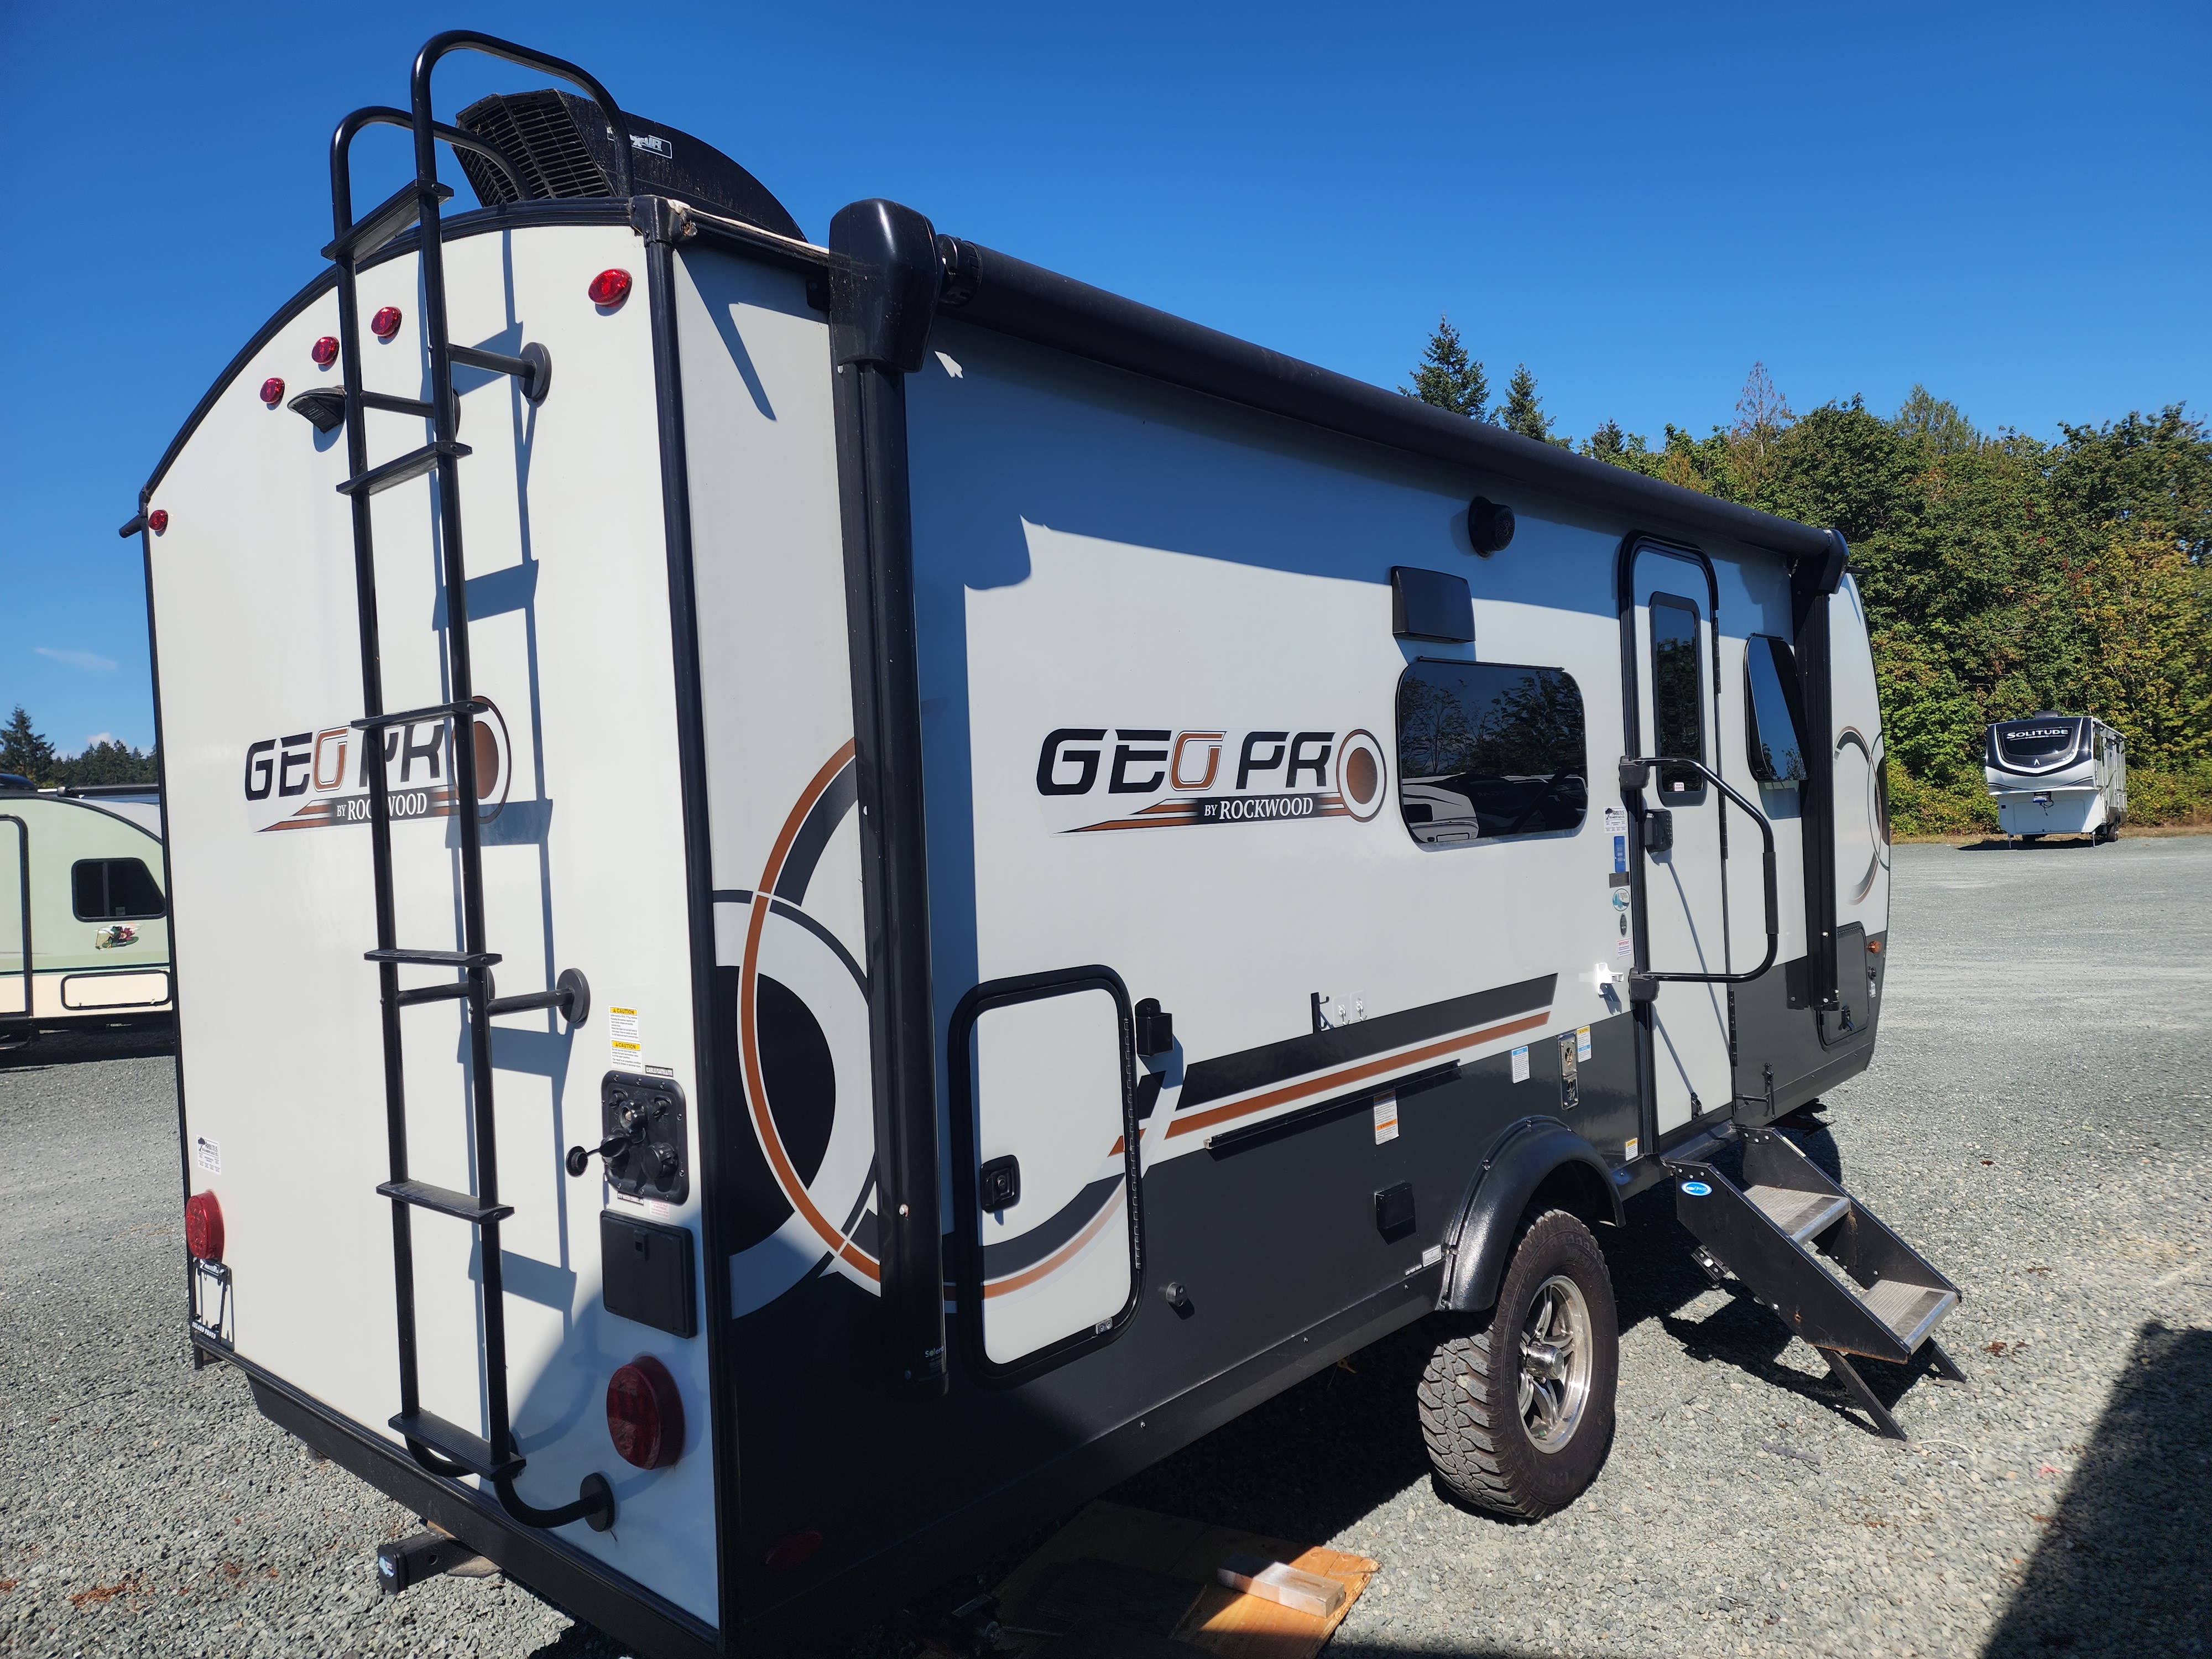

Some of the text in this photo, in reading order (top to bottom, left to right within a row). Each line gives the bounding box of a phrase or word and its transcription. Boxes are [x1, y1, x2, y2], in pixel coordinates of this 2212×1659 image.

[2006, 729, 2069, 739] SOLITUDE
[245, 725, 351, 801] GEO
[1036, 728, 1387, 823] GEO PRO
[336, 792, 427, 821] BY ROCWOOD
[1204, 797, 1313, 821] BY ROCKWOOD
